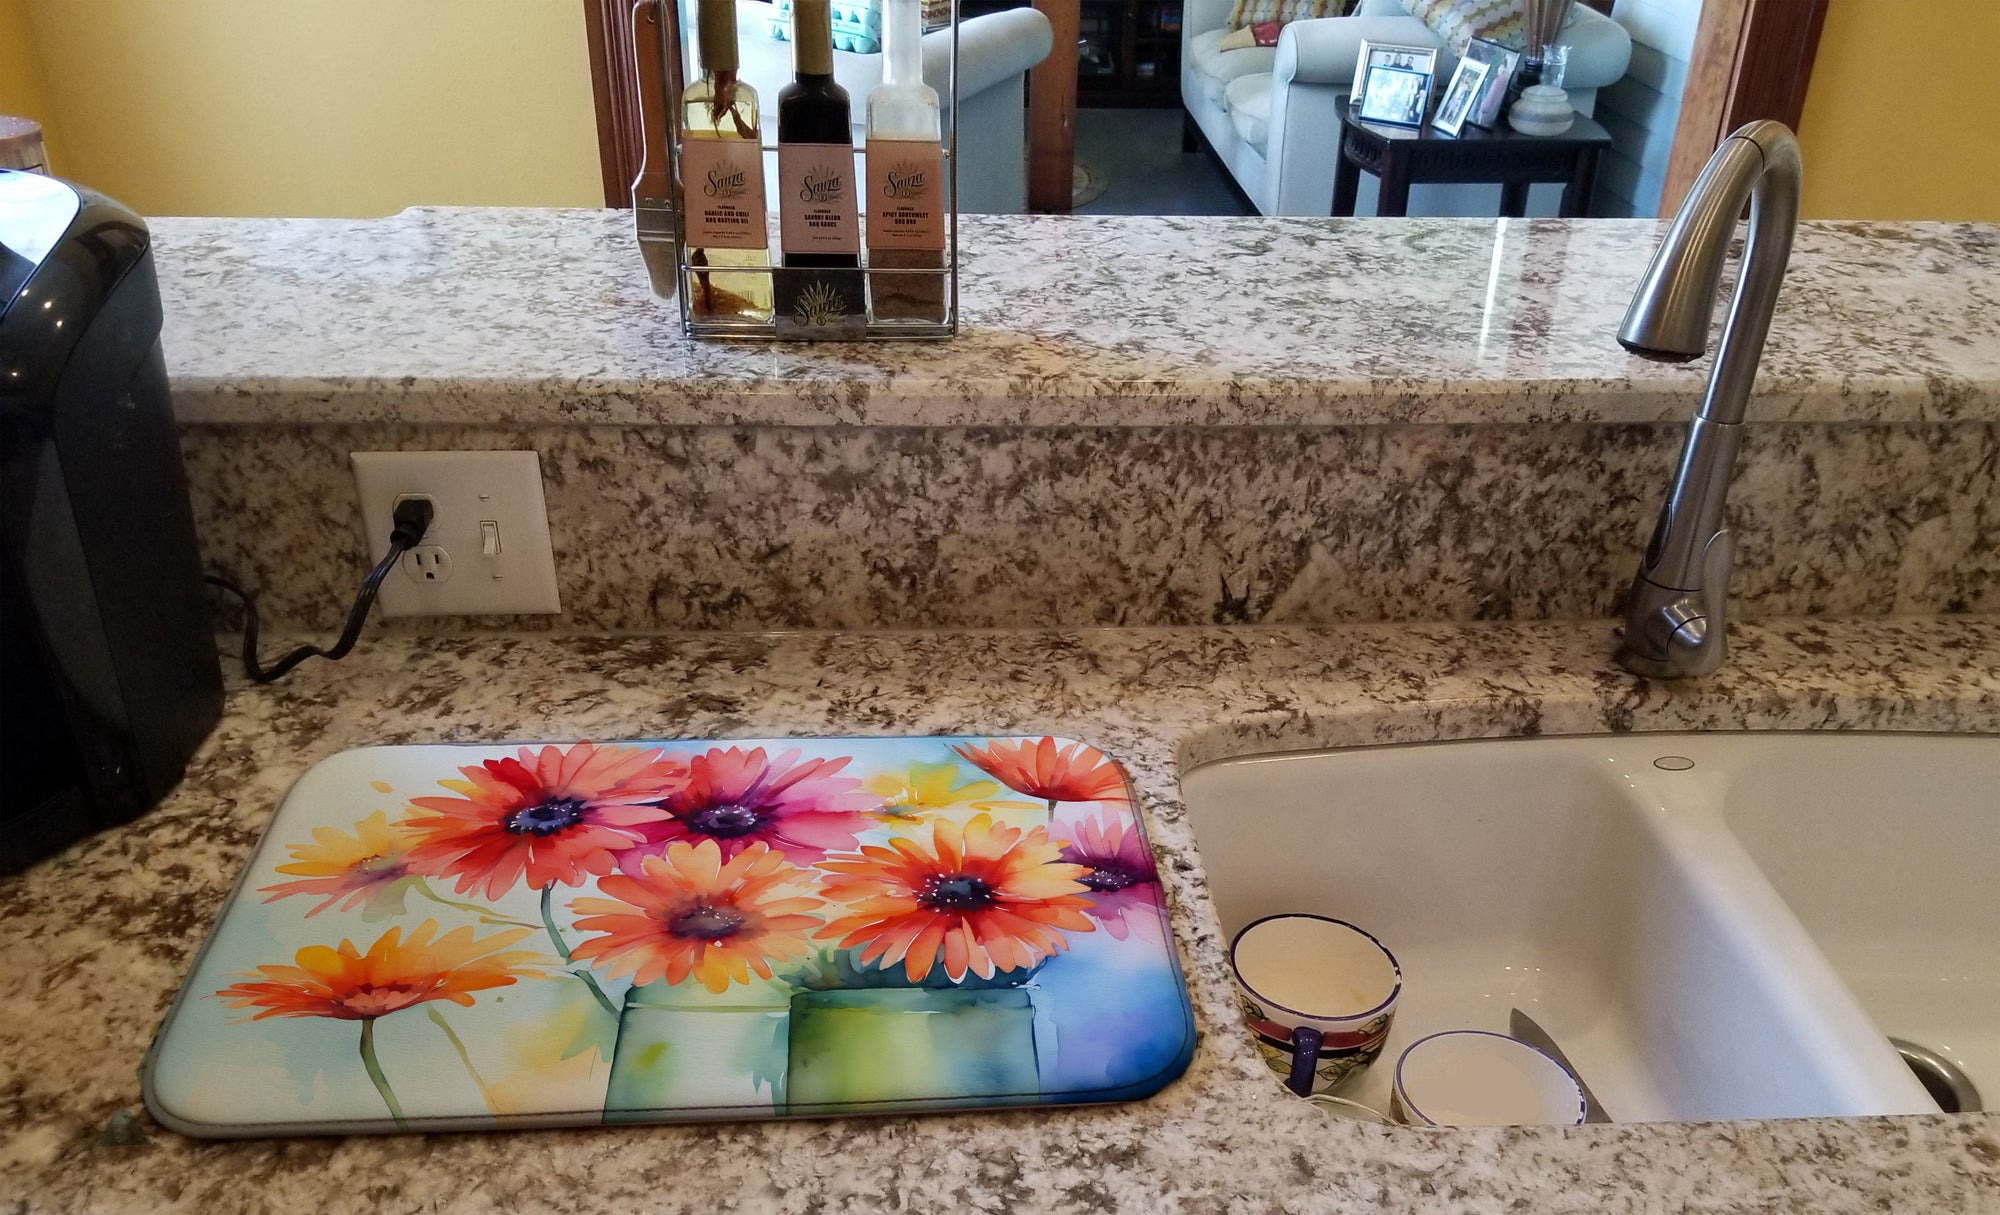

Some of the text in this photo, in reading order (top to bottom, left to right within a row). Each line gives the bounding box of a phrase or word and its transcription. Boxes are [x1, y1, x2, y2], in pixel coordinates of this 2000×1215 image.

[703, 170, 744, 197] Sauza
[800, 175, 842, 202] Sauza
[883, 171, 925, 198] Sauza
